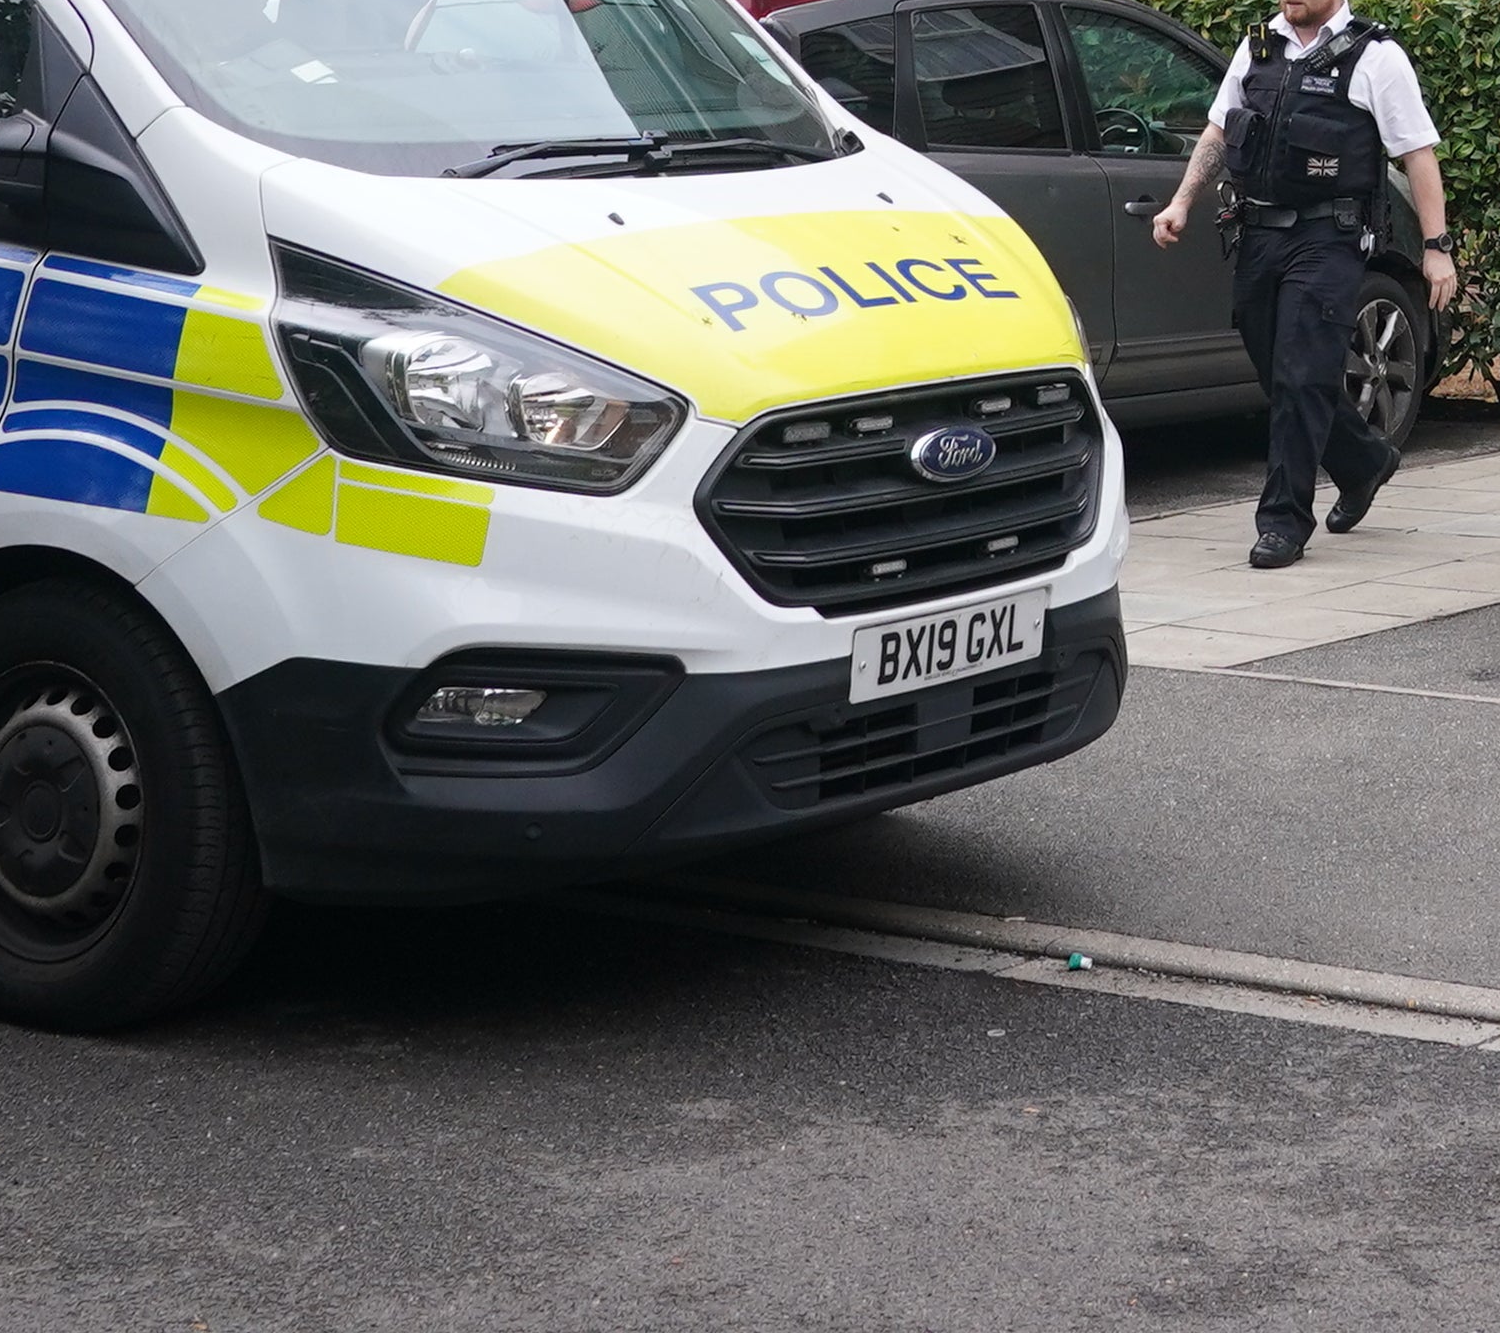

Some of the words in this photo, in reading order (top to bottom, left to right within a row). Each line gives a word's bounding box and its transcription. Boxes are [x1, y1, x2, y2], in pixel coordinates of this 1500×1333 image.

[690, 258, 1021, 332] POLICE
[938, 434, 983, 469] Ford
[877, 619, 958, 685] BX19
[966, 604, 1024, 664] GXL
